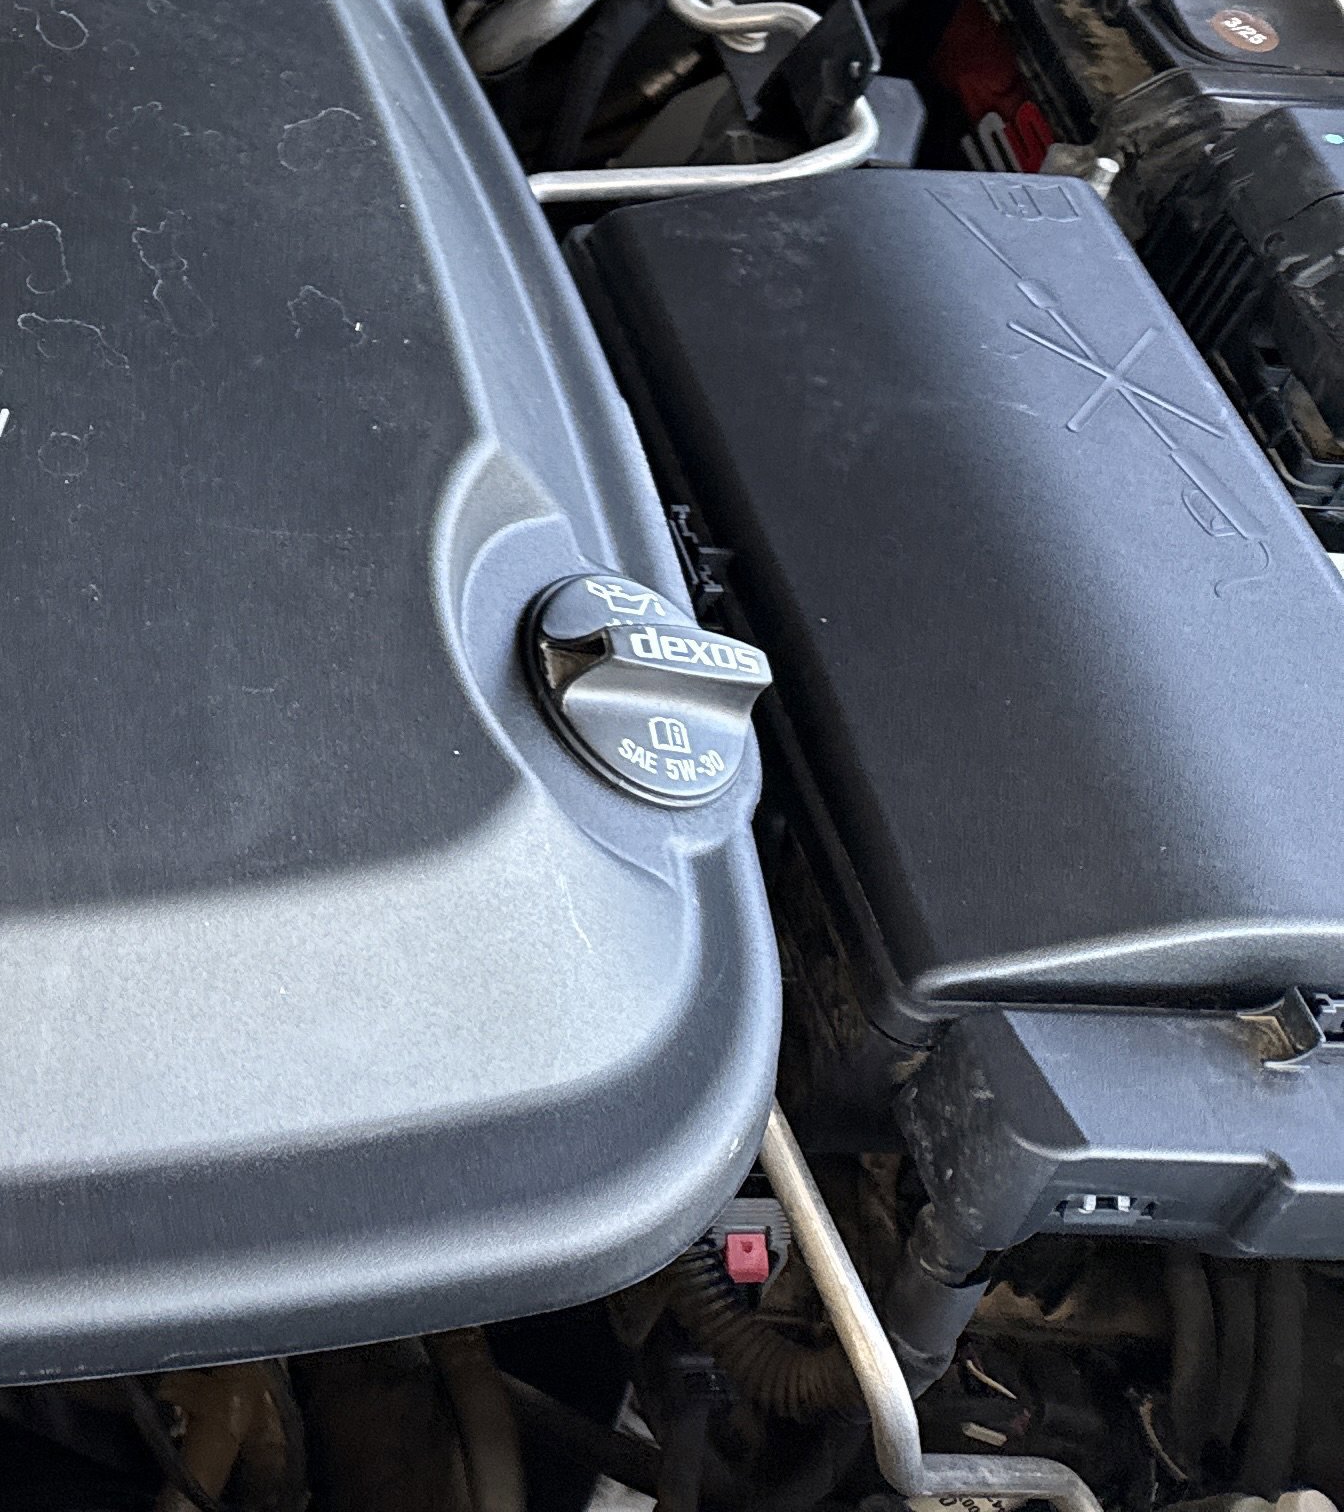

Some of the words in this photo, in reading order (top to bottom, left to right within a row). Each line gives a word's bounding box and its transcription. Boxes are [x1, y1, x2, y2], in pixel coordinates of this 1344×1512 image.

[629, 626, 761, 675] dexos
[617, 737, 659, 775] SAE
[665, 749, 725, 782] 5W-30
